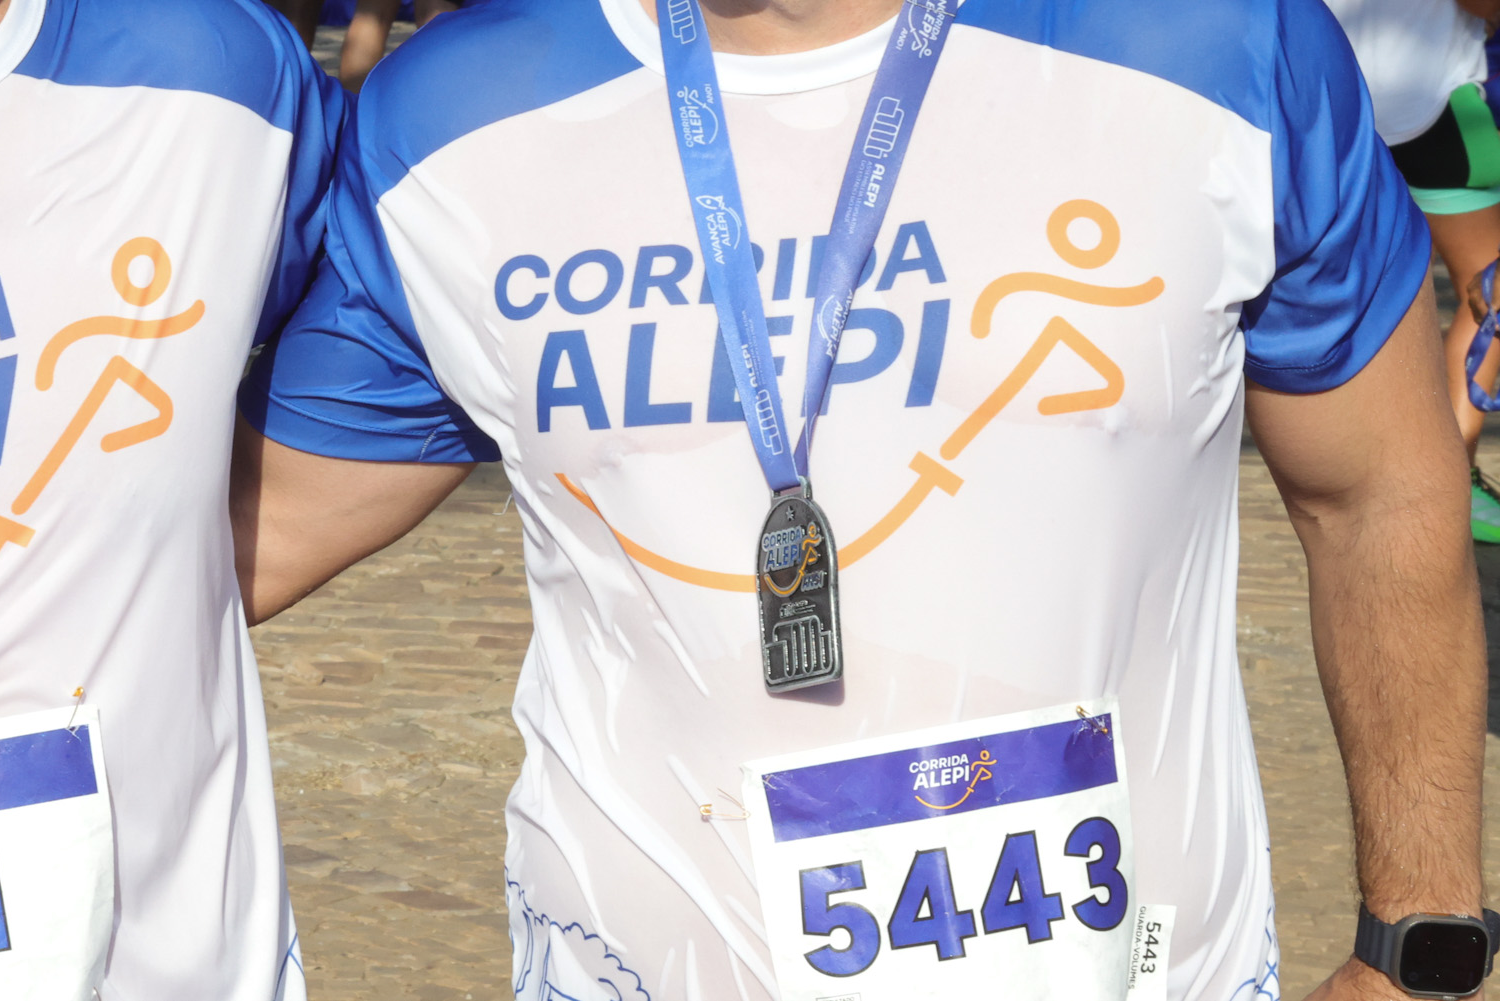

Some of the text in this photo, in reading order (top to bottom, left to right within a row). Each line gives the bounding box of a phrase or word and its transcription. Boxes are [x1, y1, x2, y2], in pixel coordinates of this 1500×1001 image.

[679, 106, 694, 147] CORRIDA
[687, 105, 706, 145] ALEPI
[863, 163, 886, 208] ALEPI
[705, 213, 725, 265] AVANÇA
[716, 212, 731, 247] ALEPI
[762, 527, 803, 549] CORRIDA
[765, 542, 803, 570] ALEPI
[909, 753, 970, 774] CORRIDA
[912, 765, 970, 791] ALEPI
[799, 815, 1129, 978] 5443
[1127, 905, 1147, 990] GUARDA-VOLUMES
[1140, 921, 1162, 974] 5443
